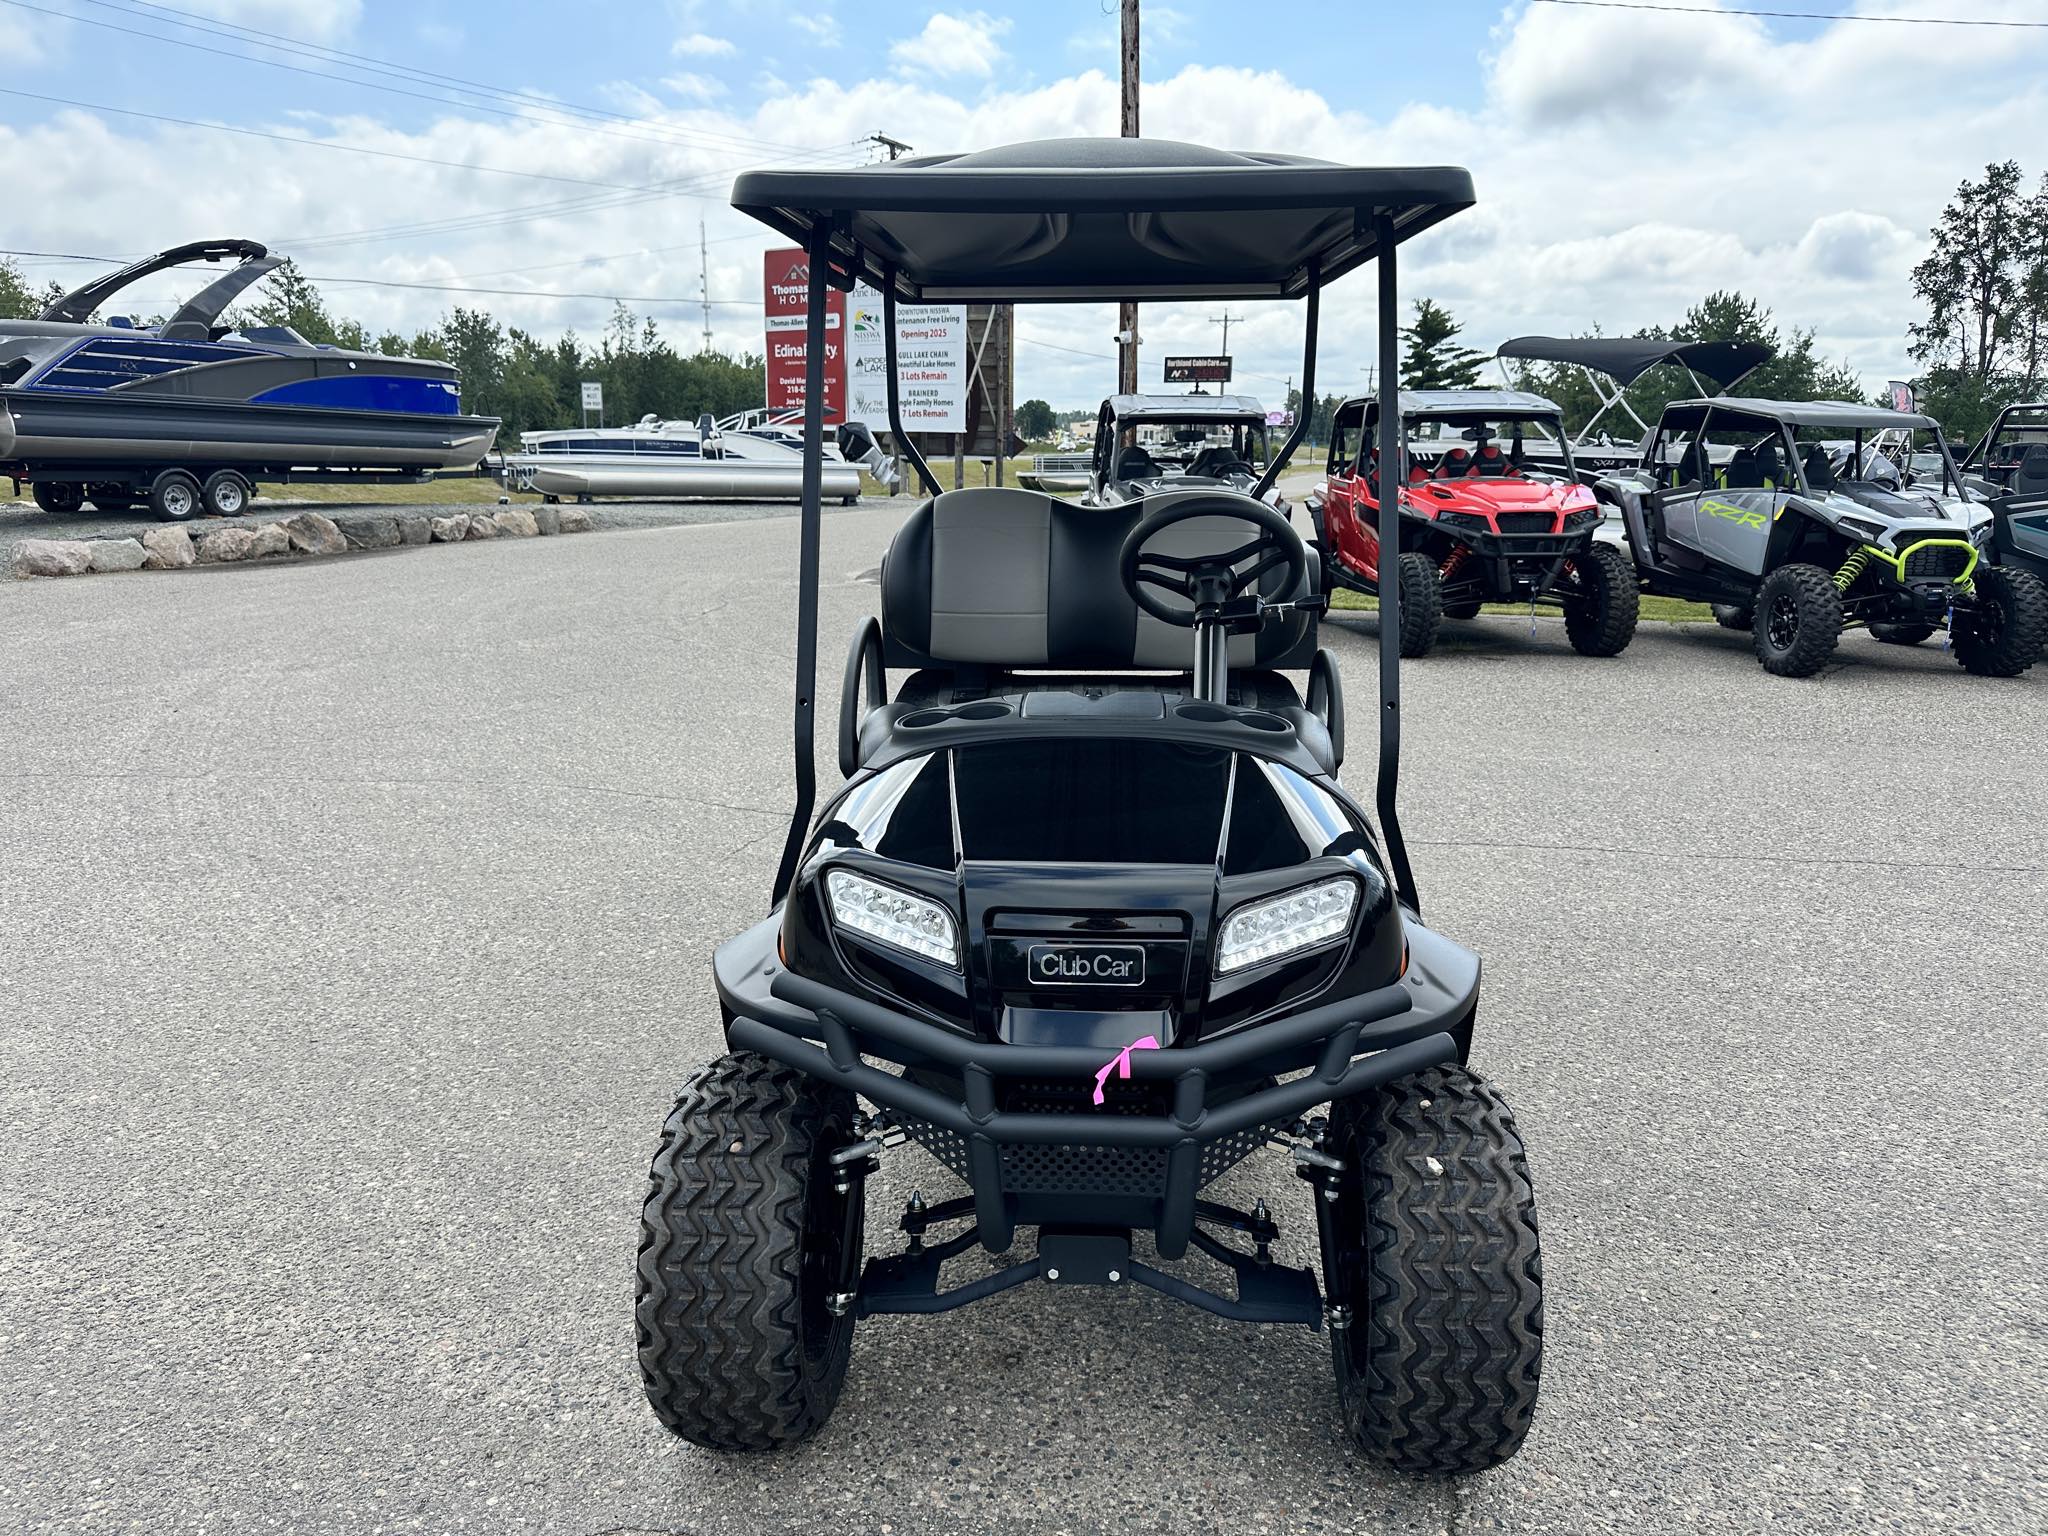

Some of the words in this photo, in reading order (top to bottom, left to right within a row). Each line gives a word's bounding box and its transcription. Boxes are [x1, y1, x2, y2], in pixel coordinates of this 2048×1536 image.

[897, 308, 929, 316] DOWNTOWN
[929, 306, 950, 315] NISSWA
[927, 315, 940, 323] Free
[941, 315, 960, 325] Living
[854, 331, 881, 339] NISSWA
[901, 330, 929, 340] Opening
[929, 329, 947, 338] 2025
[898, 351, 913, 359] GULL
[914, 351, 928, 359] LAKE
[929, 350, 949, 358] CHAIN
[922, 360, 936, 368] Lake
[937, 360, 956, 368] Homes
[901, 372, 905, 380] 3
[906, 371, 921, 380] Lots
[922, 371, 948, 380] Remain
[908, 389, 939, 397] BRAINERD
[912, 398, 932, 408] Family
[933, 399, 954, 407] Homes
[902, 410, 906, 418] 7
[908, 410, 922, 418] Lots
[922, 410, 949, 418] Remain
[1592, 459, 1615, 468] SX22
[1698, 500, 1767, 530] RZR
[1040, 953, 1091, 977] Club
[1093, 954, 1134, 977] Car
